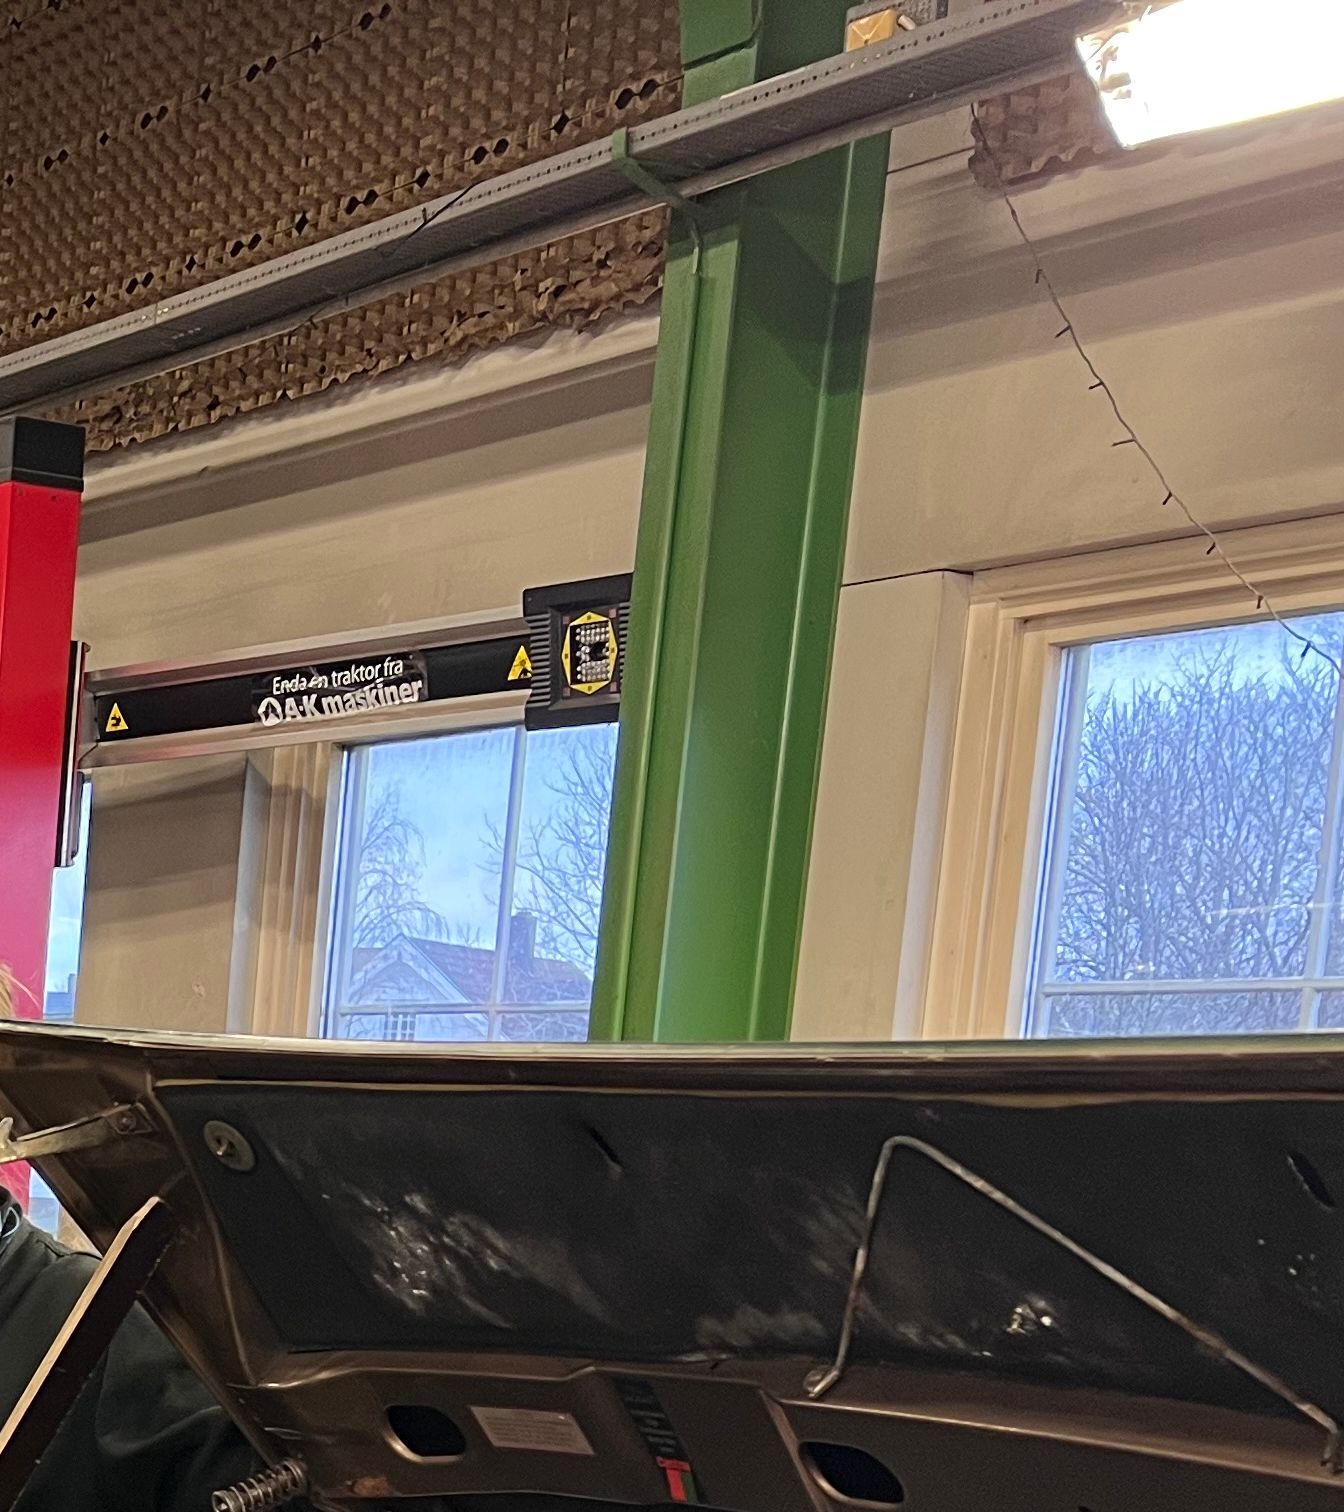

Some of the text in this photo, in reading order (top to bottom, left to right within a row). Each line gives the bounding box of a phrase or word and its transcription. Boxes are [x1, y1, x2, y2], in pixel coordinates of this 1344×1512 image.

[272, 673, 307, 696] Enda
[331, 663, 382, 688] traktor
[383, 656, 404, 677] fra
[321, 679, 424, 716] maskiner
